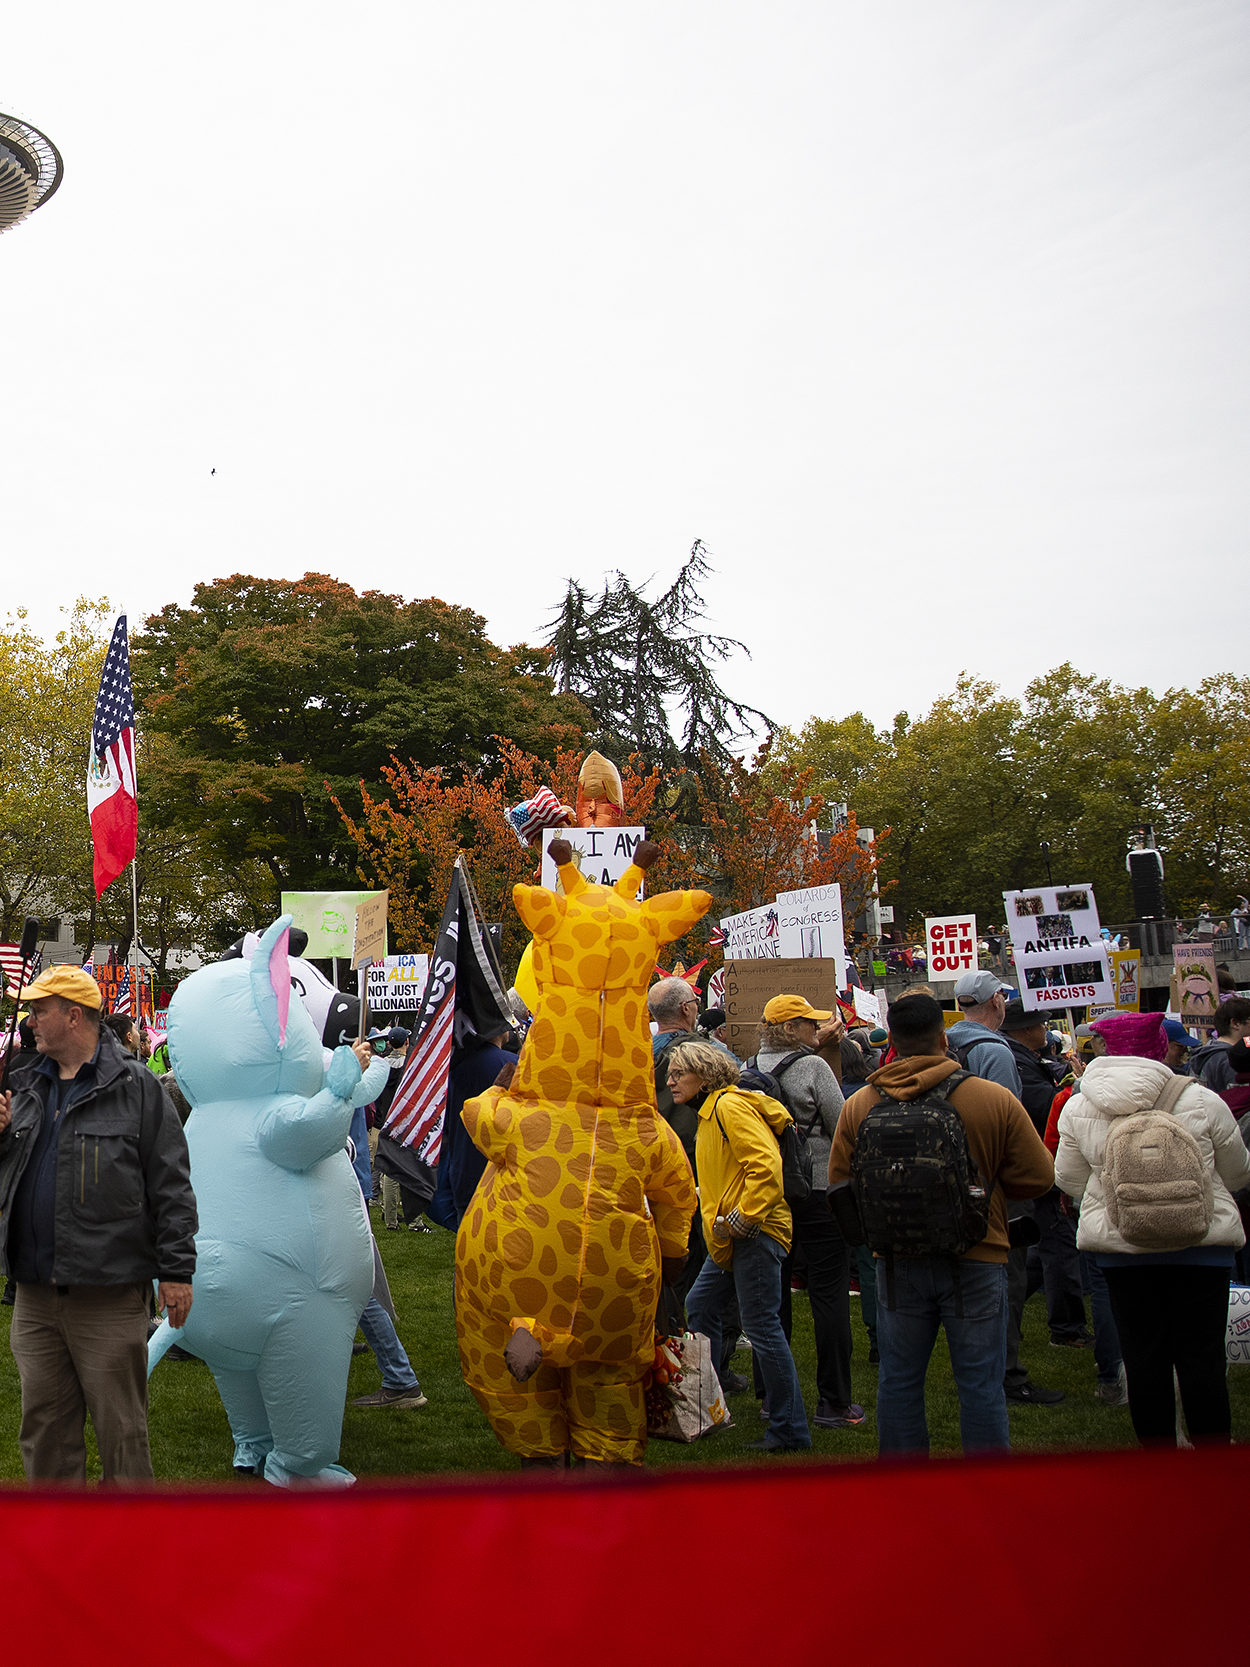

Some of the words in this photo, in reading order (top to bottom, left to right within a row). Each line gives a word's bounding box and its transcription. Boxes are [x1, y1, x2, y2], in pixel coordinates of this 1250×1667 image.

[587, 831, 604, 857] I
[614, 833, 641, 858] AM
[778, 886, 836, 907] COWARDS
[726, 912, 757, 932] MAKE
[781, 910, 840, 928] CONGRESS
[730, 926, 768, 949] AMERIC
[930, 923, 971, 940] GET
[931, 938, 973, 955] HIM
[1024, 935, 1092, 954] ANTIFA
[1191, 948, 1213, 958] FRIENDS
[932, 955, 973, 971] OUT
[97, 964, 144, 982] INGS!
[388, 967, 419, 982] ALL
[368, 985, 388, 996] NOT
[391, 984, 418, 996] JUST
[1036, 985, 1096, 1002] FASCISTS
[368, 997, 421, 1010] LLIONAIRE
